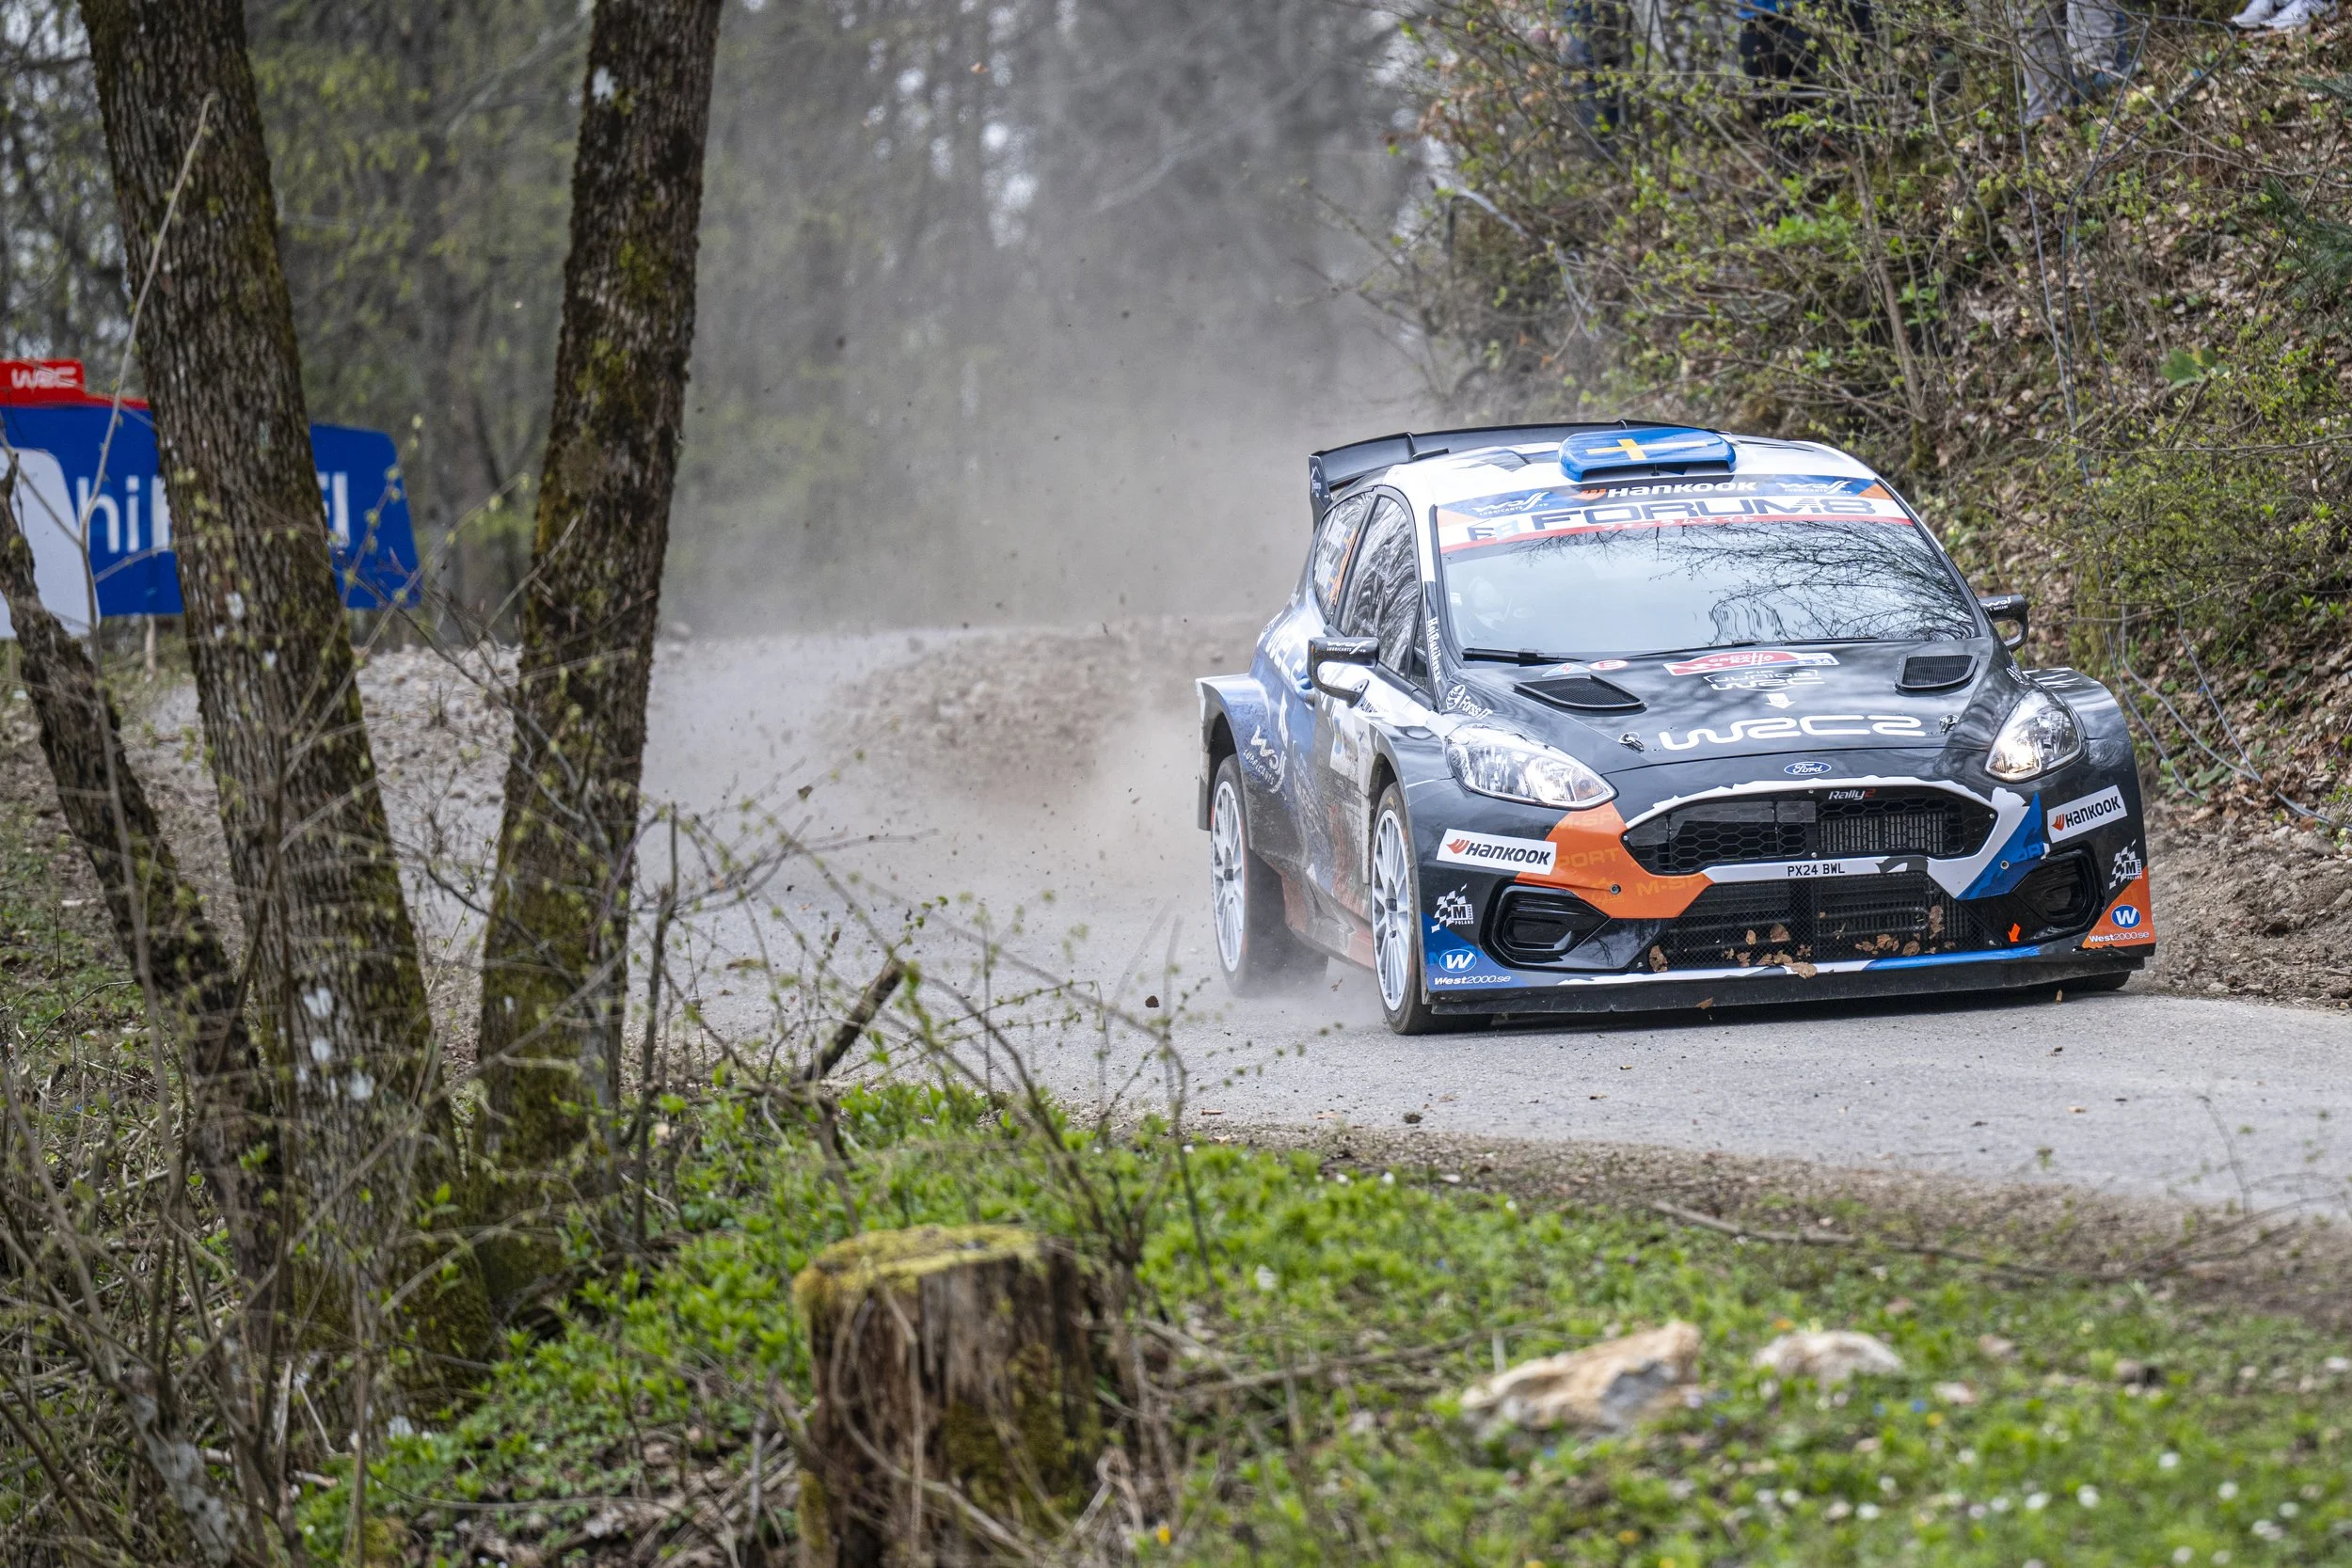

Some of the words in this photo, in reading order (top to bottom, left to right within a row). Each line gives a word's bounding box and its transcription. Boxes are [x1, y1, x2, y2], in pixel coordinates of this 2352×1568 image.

[1531, 498, 1876, 531] FORUM8
[1710, 677, 1826, 690] WRC
[1658, 715, 1927, 751] WRC2
[1793, 763, 1824, 774] Ford
[1828, 788, 1878, 800] Rally2
[1788, 864, 1819, 877] PX24
[1822, 863, 1846, 875] BWL
[2125, 861, 2137, 875] M
[1453, 906, 1467, 919] M
[2115, 908, 2137, 926] W
[2089, 931, 2150, 942] West2000.se
[1446, 952, 1474, 970] W
[1434, 974, 1512, 986] West2000.se
